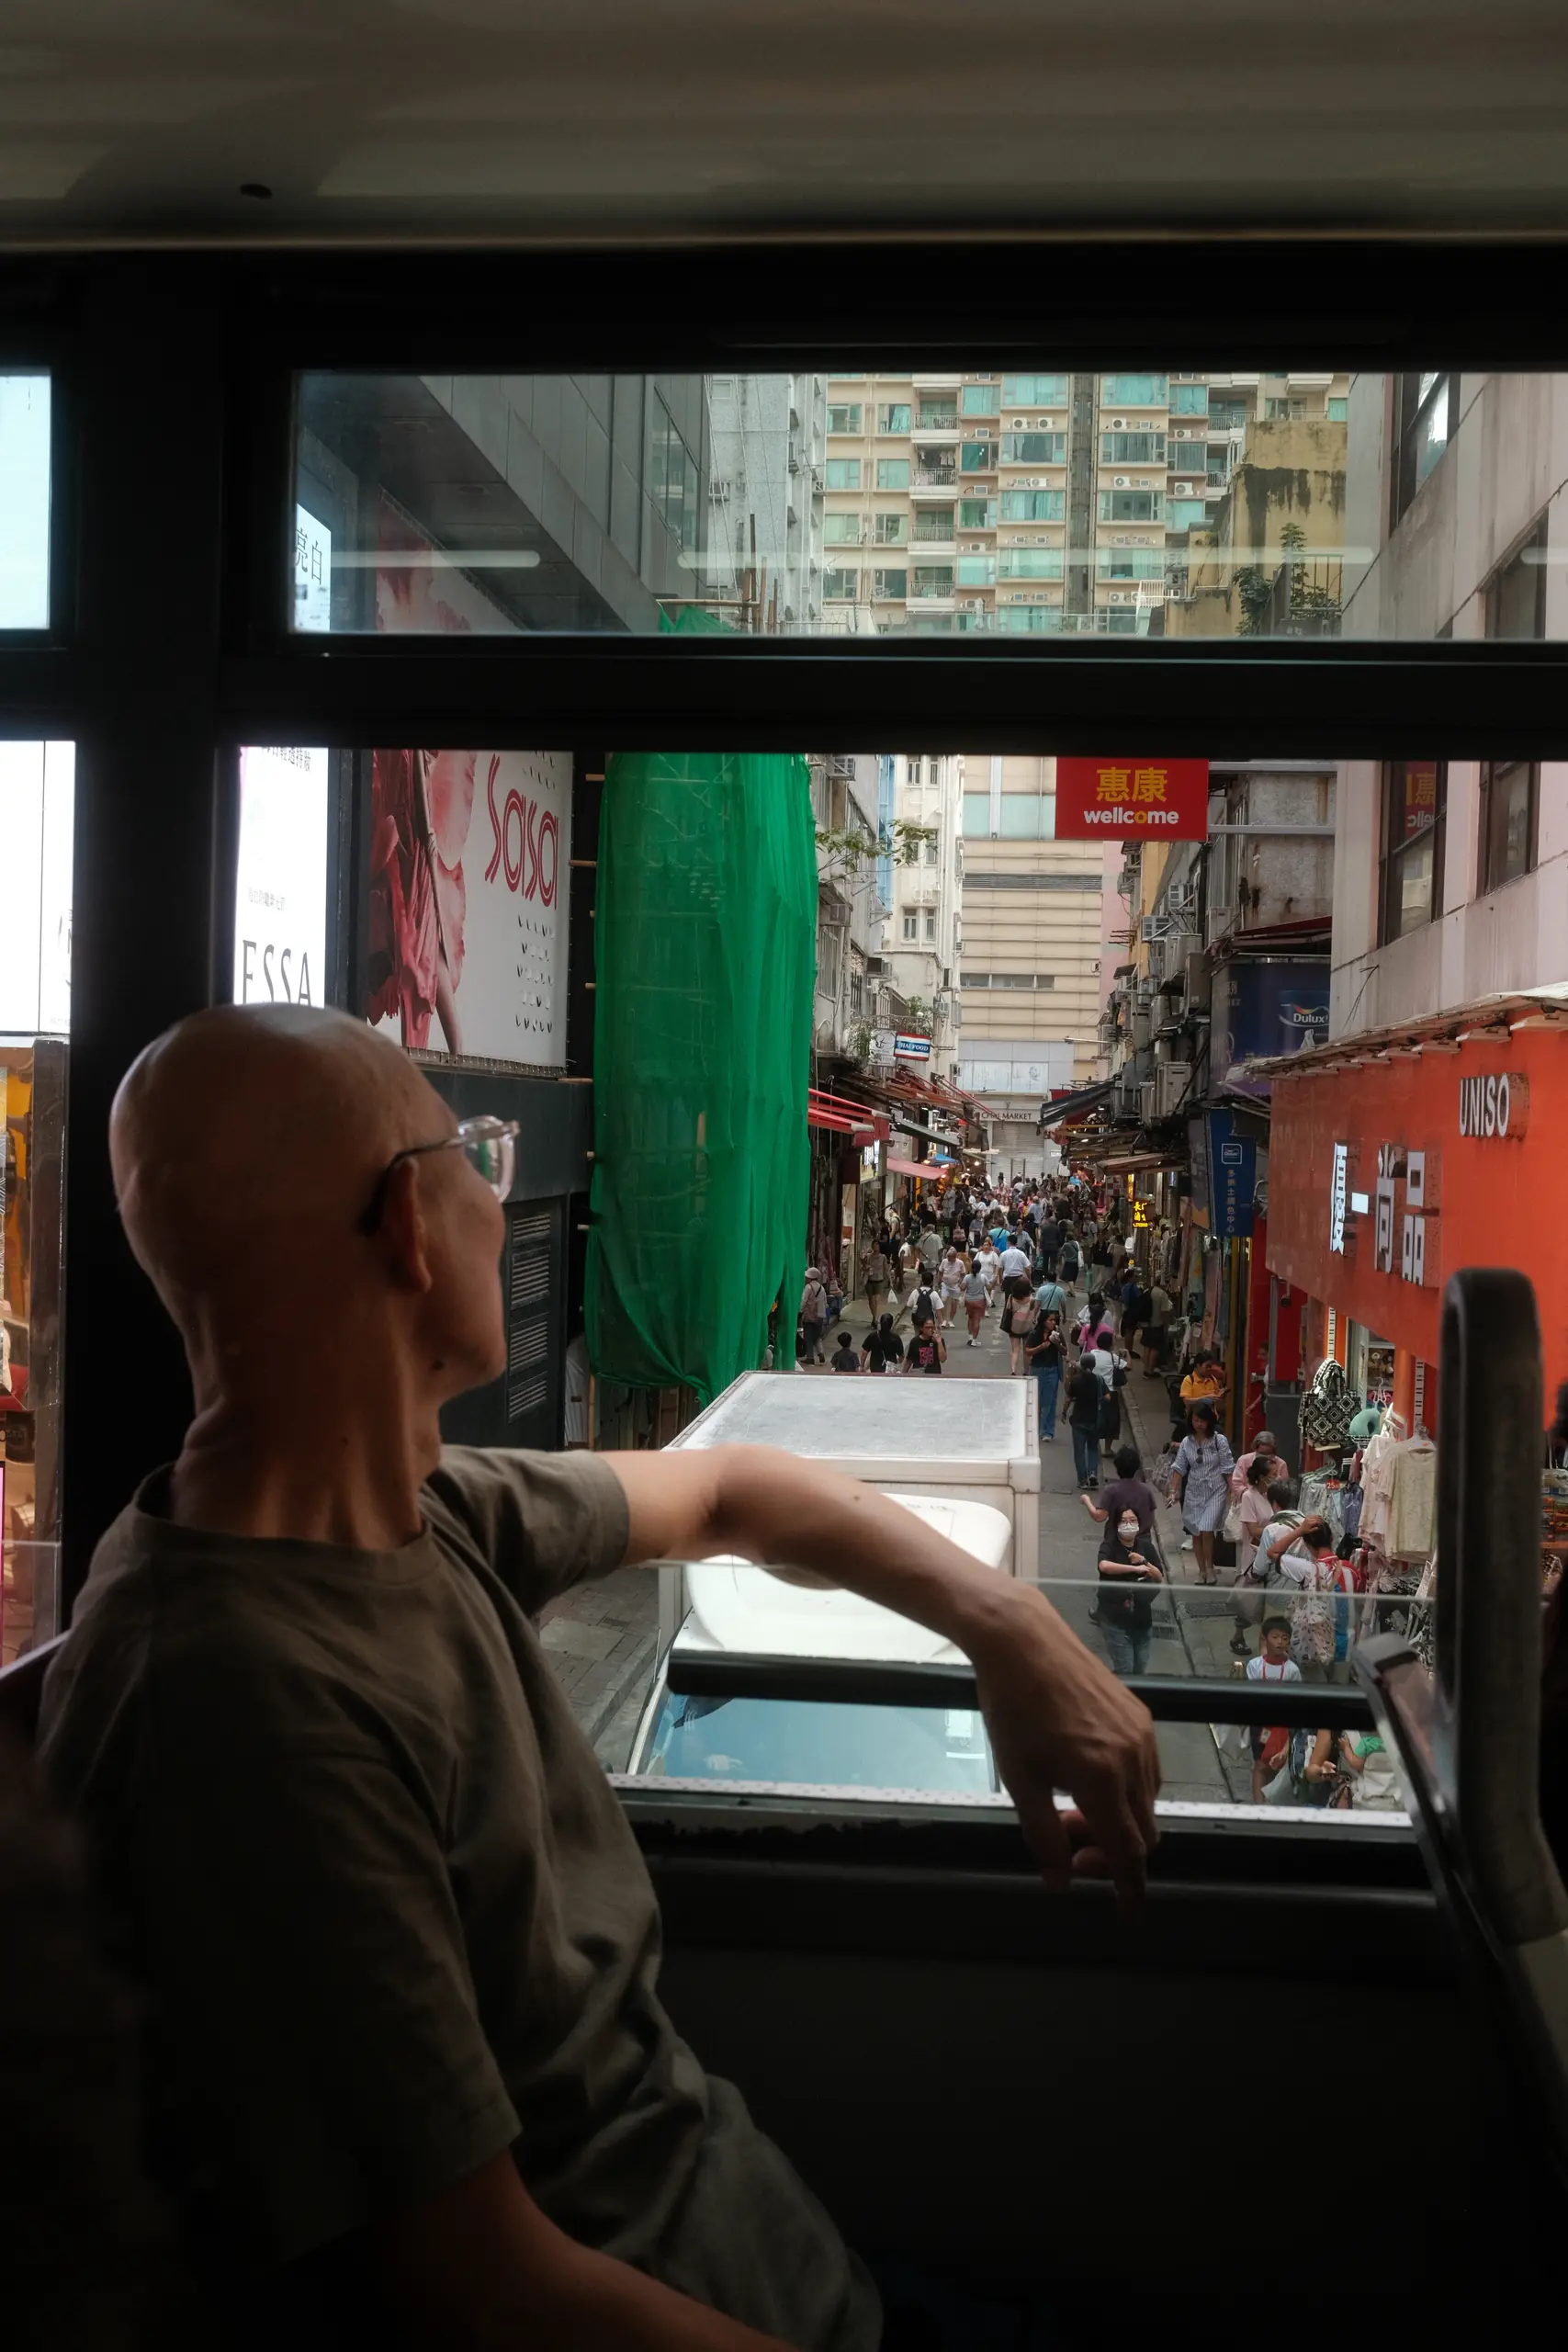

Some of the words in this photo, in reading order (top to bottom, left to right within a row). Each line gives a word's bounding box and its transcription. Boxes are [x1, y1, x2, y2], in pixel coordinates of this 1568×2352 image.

[296, 527, 322, 585] 亮白
[1096, 767, 1168, 802] 惠康
[1084, 807, 1179, 824] wellcome
[1293, 1013, 1325, 1023] Dulux
[897, 1041, 911, 1049] THAI
[911, 1043, 929, 1052] FOOD
[1459, 1073, 1510, 1138] UNISO
